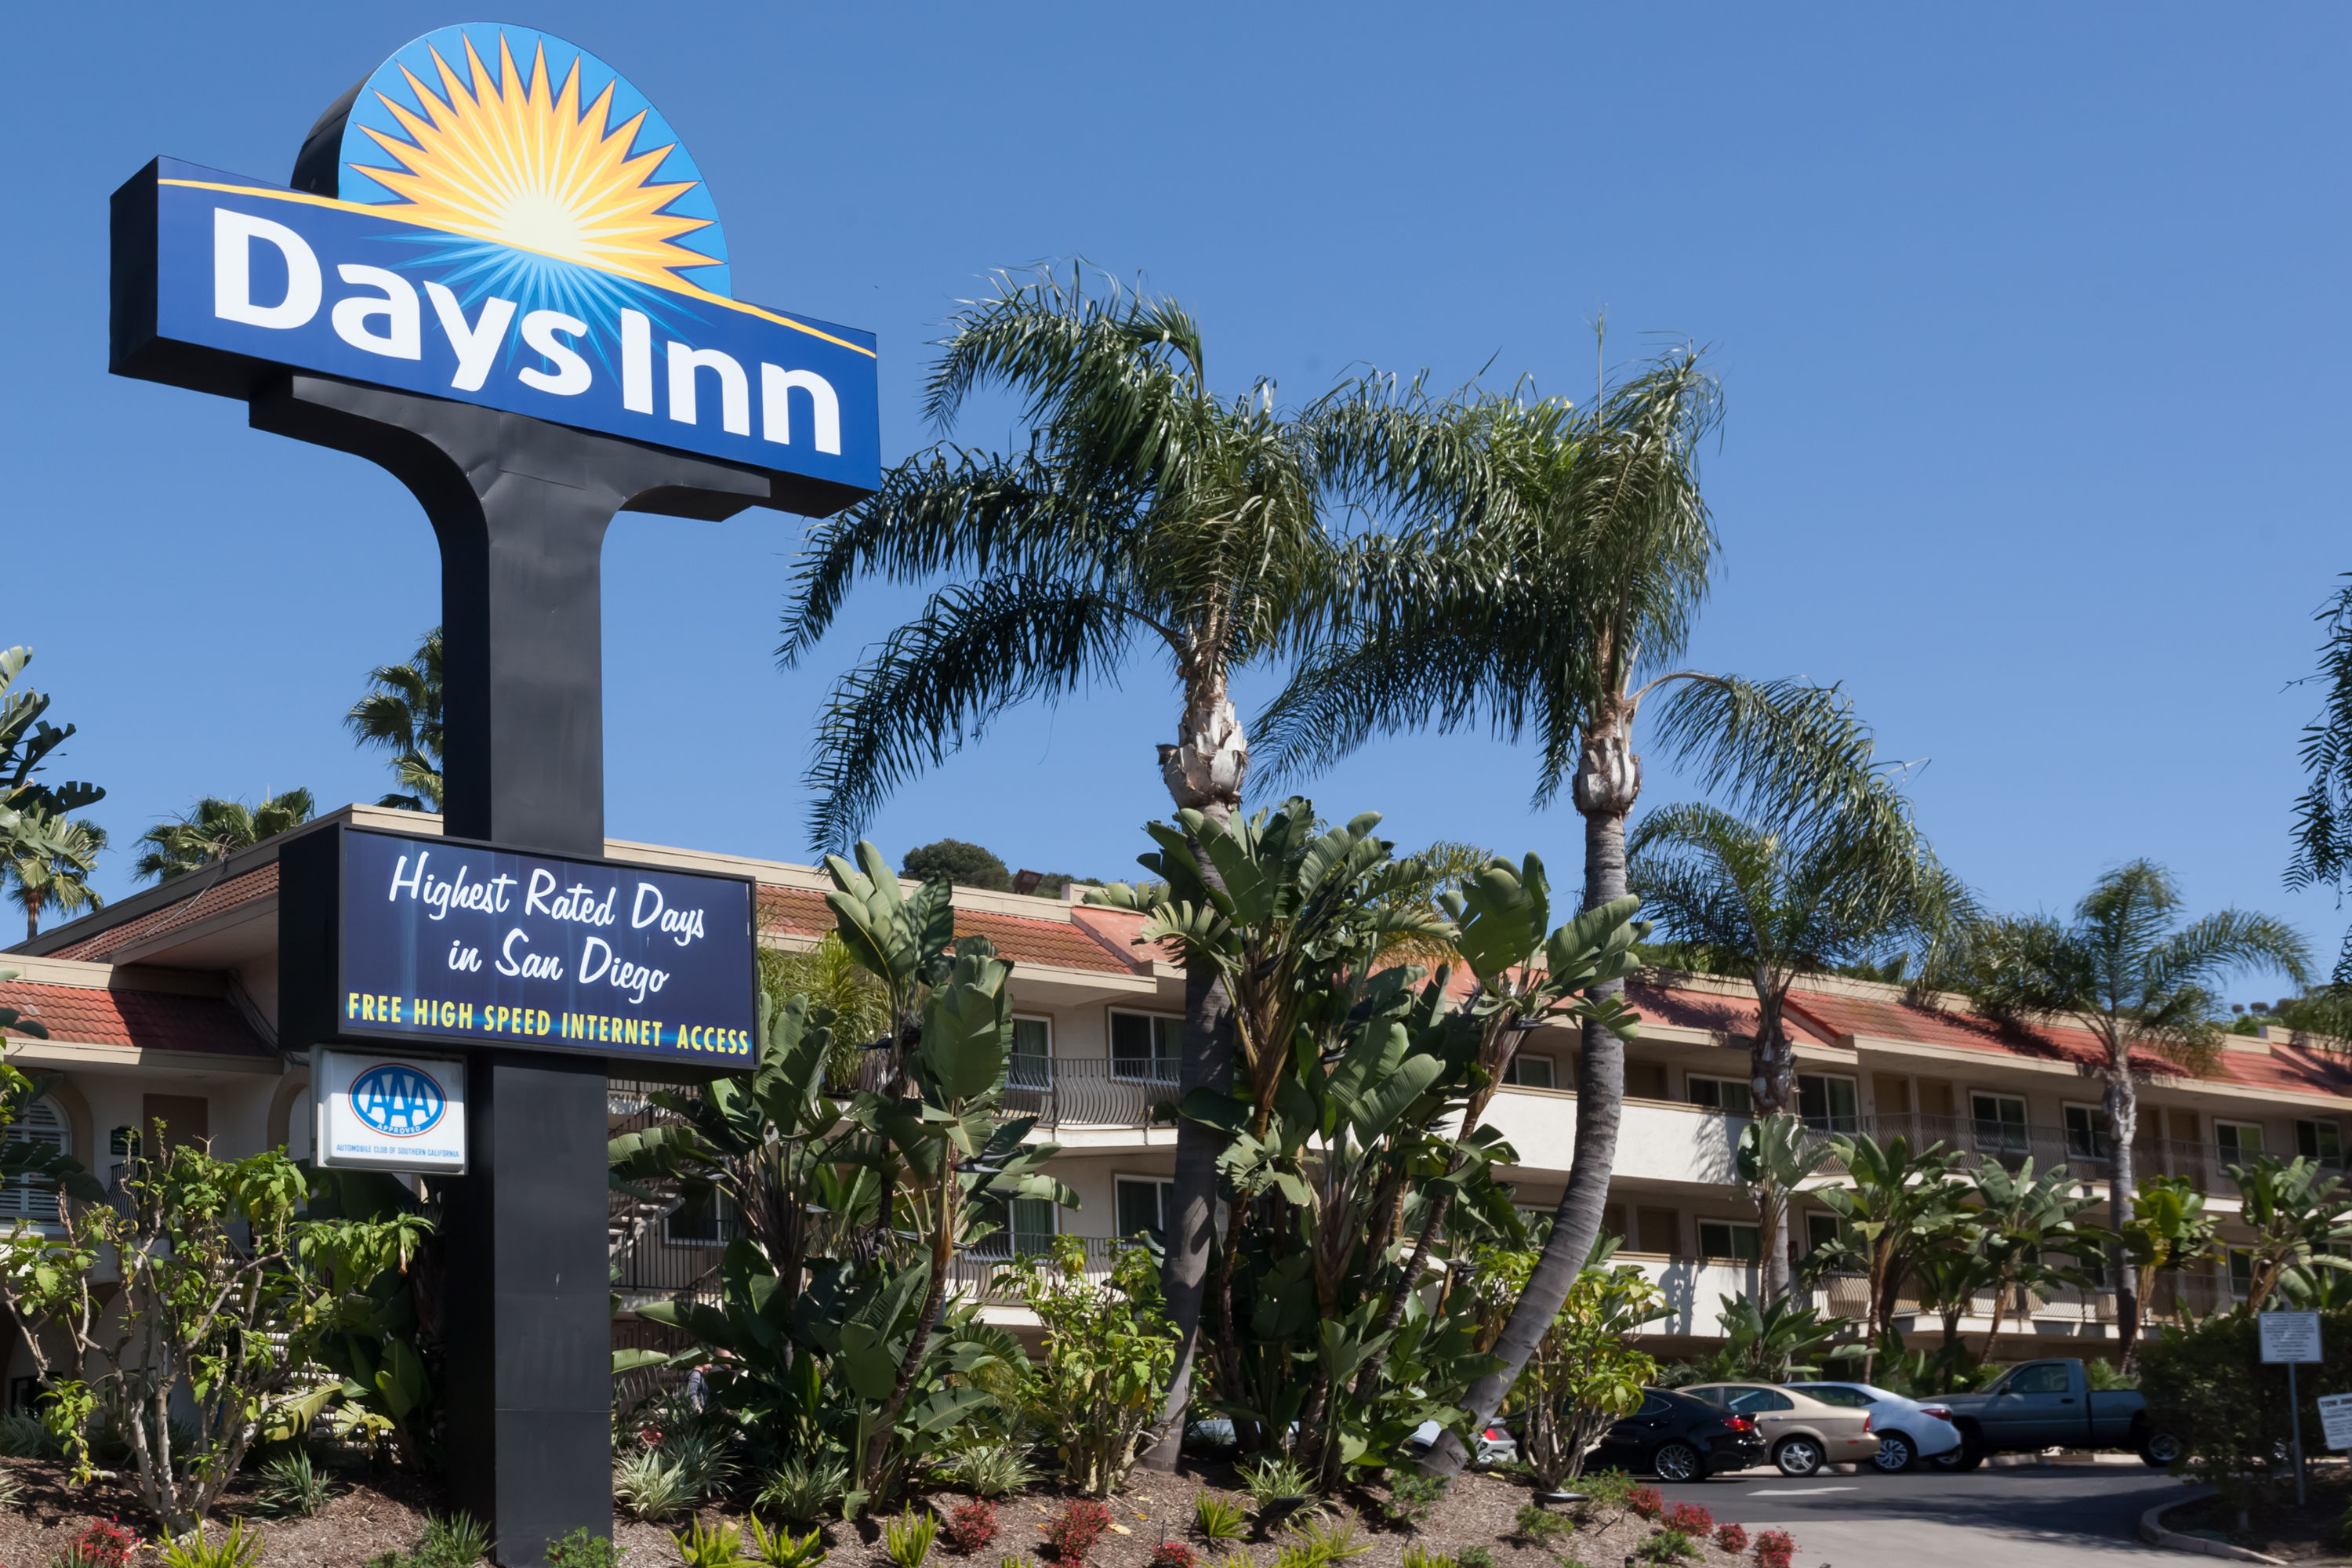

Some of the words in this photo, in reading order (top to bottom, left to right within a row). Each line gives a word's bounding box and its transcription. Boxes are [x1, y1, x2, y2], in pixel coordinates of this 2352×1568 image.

[215, 207, 593, 396] Days
[620, 307, 842, 456] Inn
[389, 851, 518, 920] Highest
[524, 868, 616, 927] Rated
[631, 882, 706, 947] Days
[448, 940, 482, 972] in
[495, 927, 564, 981] San
[579, 936, 670, 1004] Diego
[348, 993, 402, 1023] FREE
[413, 998, 473, 1029] HIGH
[484, 1004, 550, 1036] SPEED
[561, 1012, 662, 1047] INTERNET
[677, 1024, 750, 1055] ACCESS
[366, 1072, 431, 1127] AAA
[376, 1123, 421, 1134] APPROVED
[336, 1144, 372, 1152] AUTOMOBILE
[397, 1147, 426, 1156] SOUTHERN
[427, 1149, 459, 1158] CALIFORNIA
